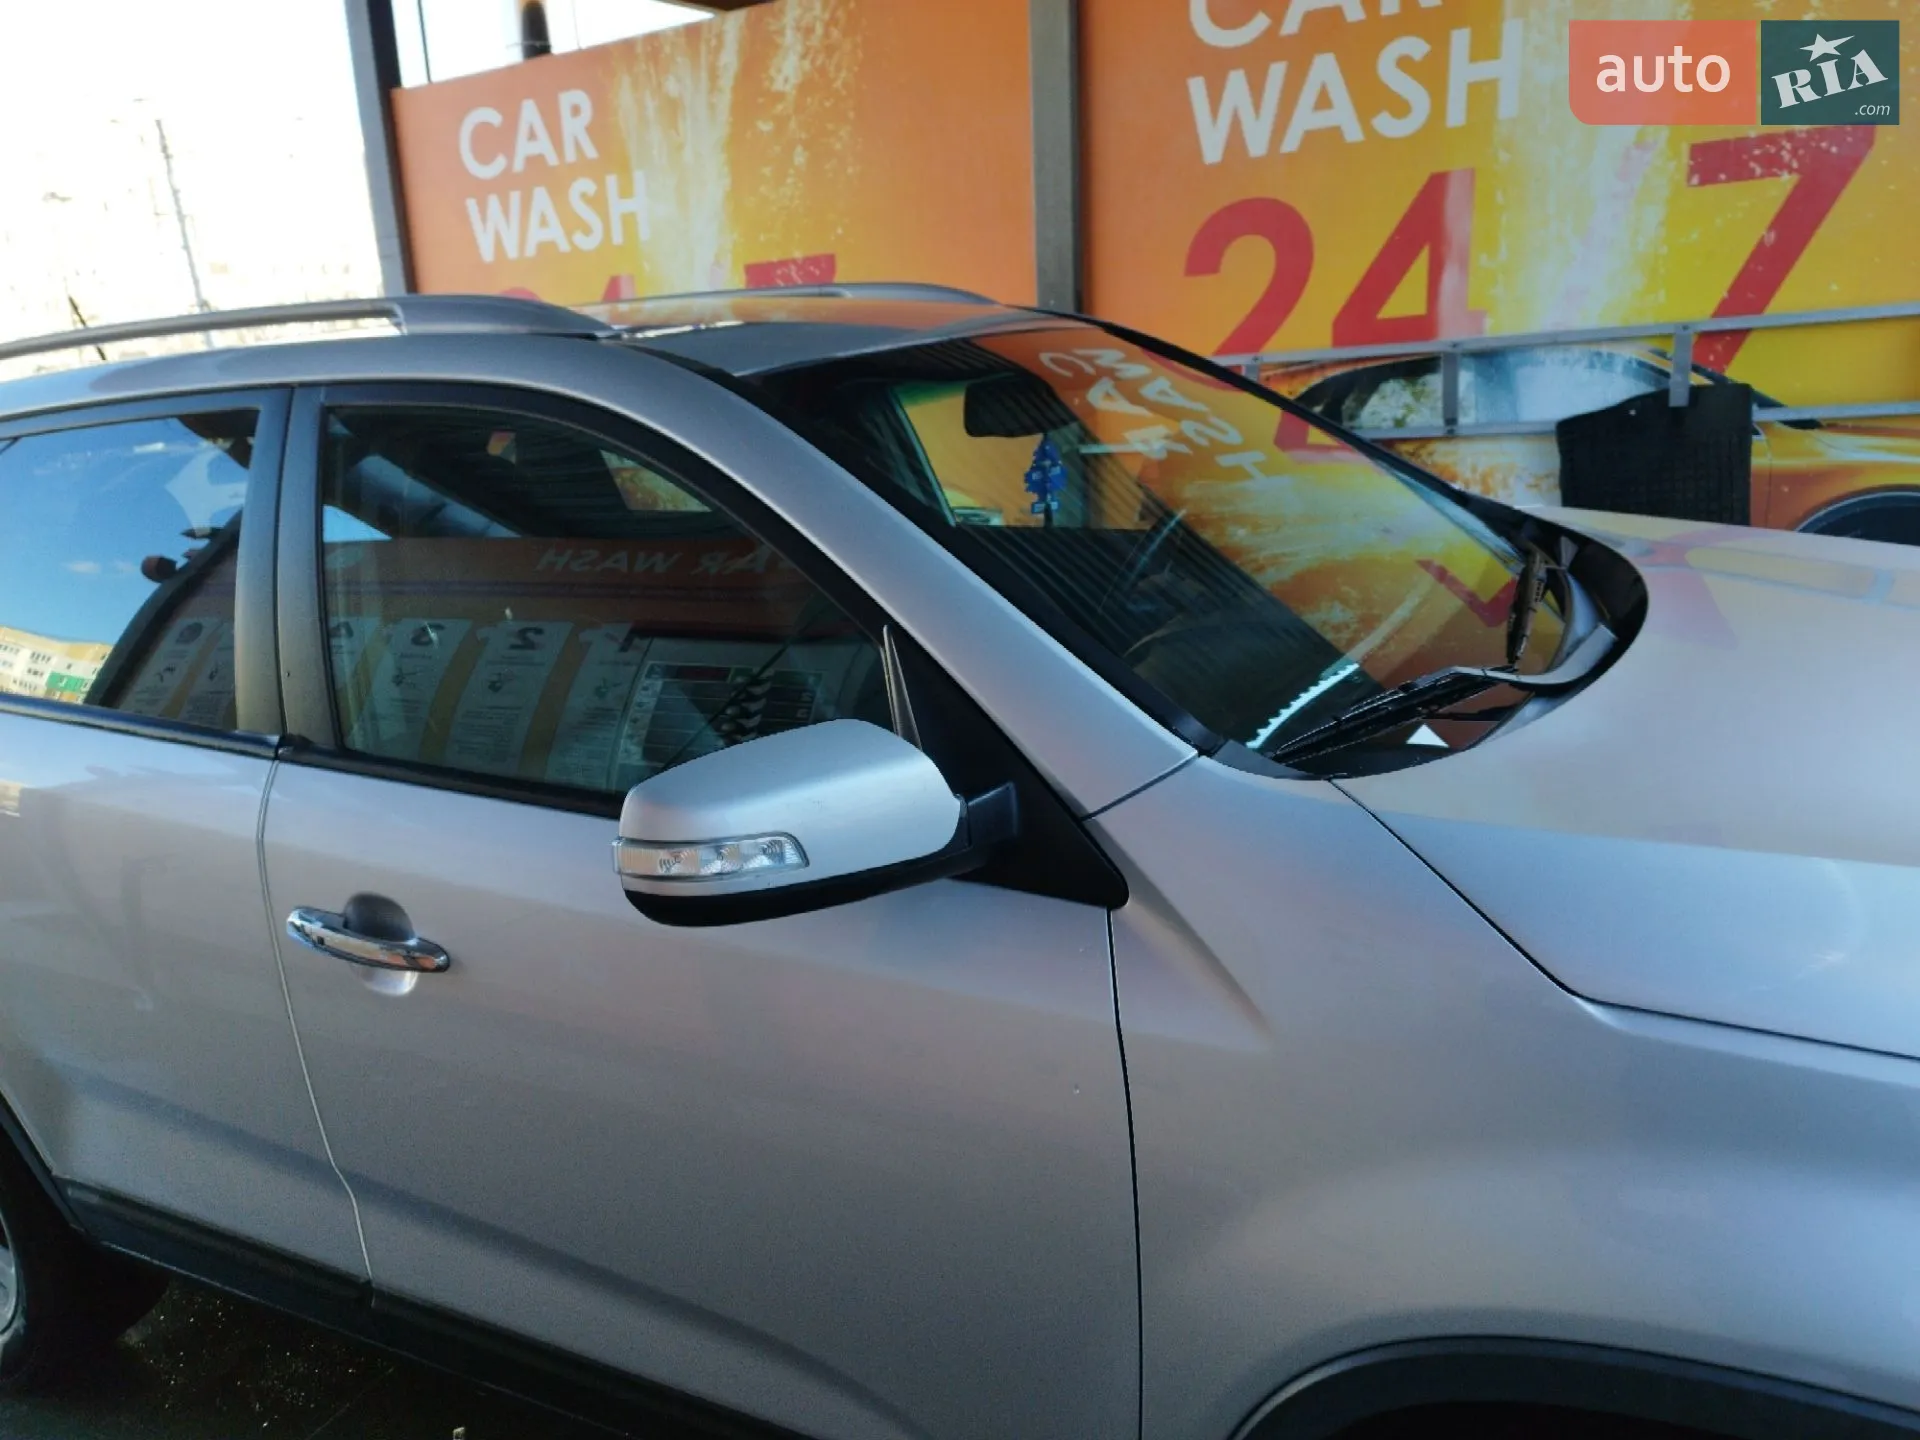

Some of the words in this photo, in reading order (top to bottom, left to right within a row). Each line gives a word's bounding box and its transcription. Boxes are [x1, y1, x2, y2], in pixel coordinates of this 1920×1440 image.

[459, 89, 599, 180] CAR
[1186, 17, 1524, 165] WASH
[465, 169, 651, 263] WASH
